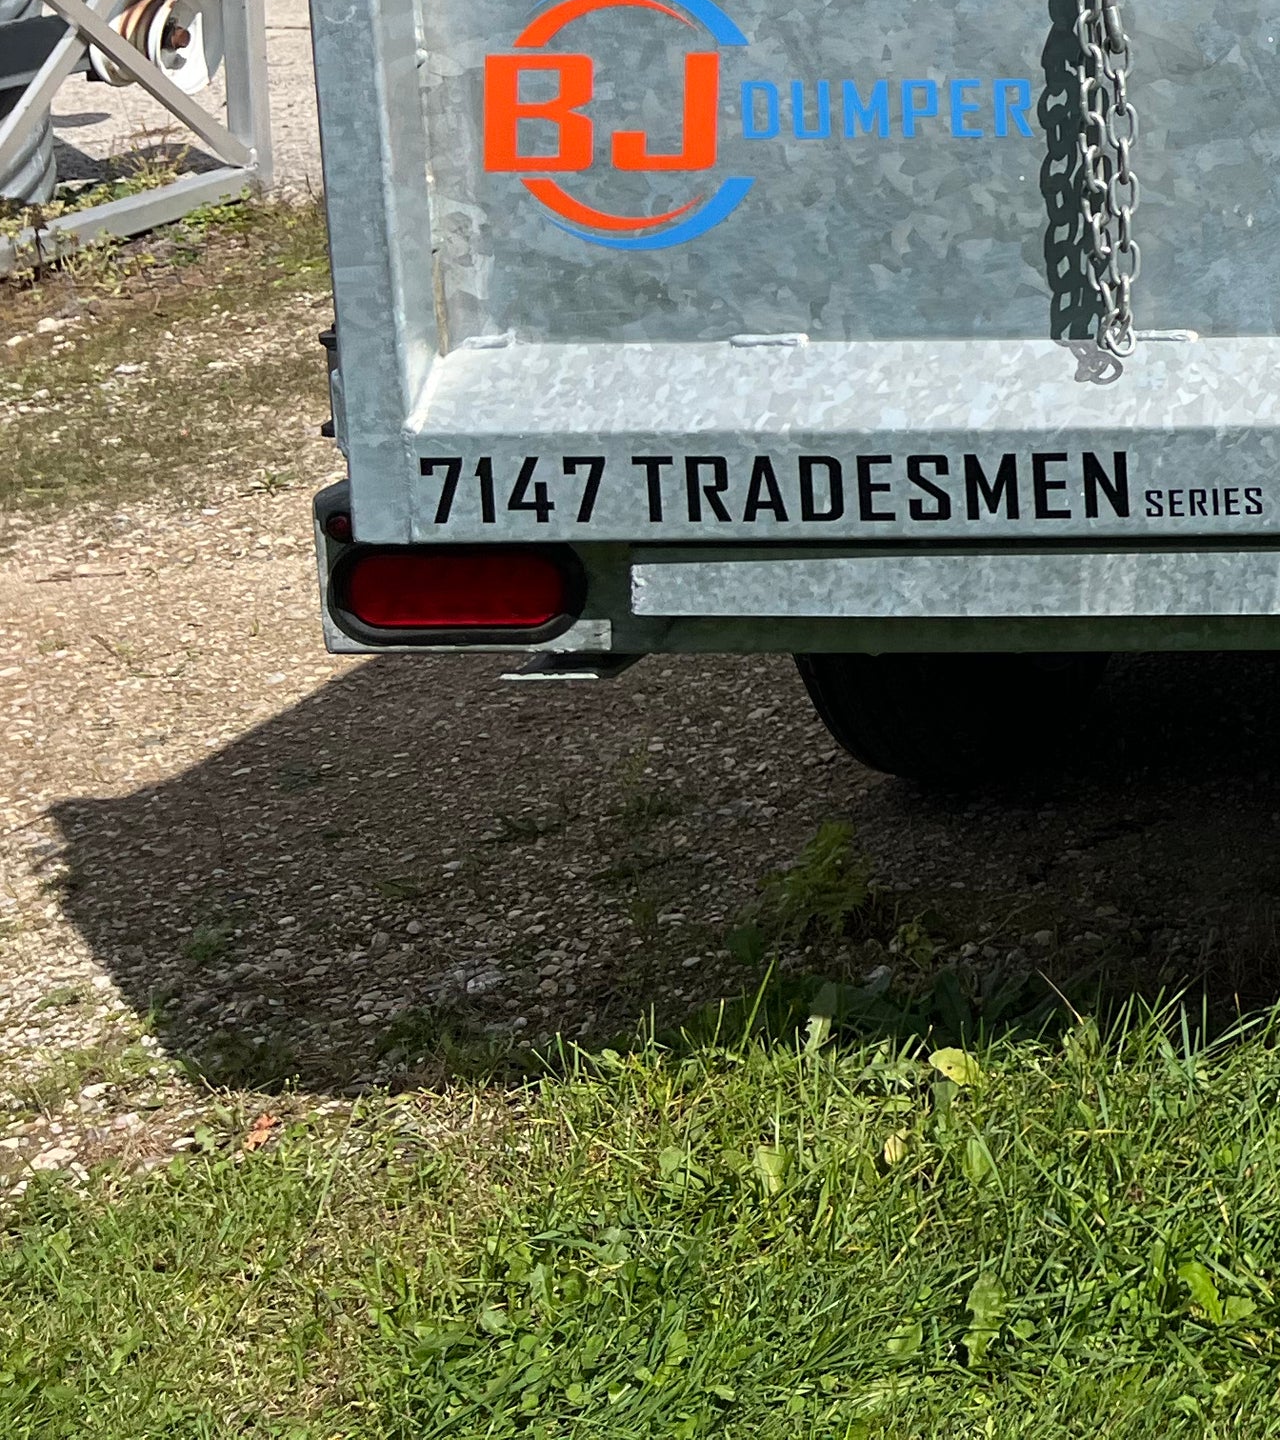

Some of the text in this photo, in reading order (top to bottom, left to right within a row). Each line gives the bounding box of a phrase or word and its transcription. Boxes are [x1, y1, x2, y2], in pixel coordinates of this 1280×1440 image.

[483, 52, 1034, 173] BJ DUMPER
[419, 451, 1264, 524] 7147 TRADESMEN SERIES
